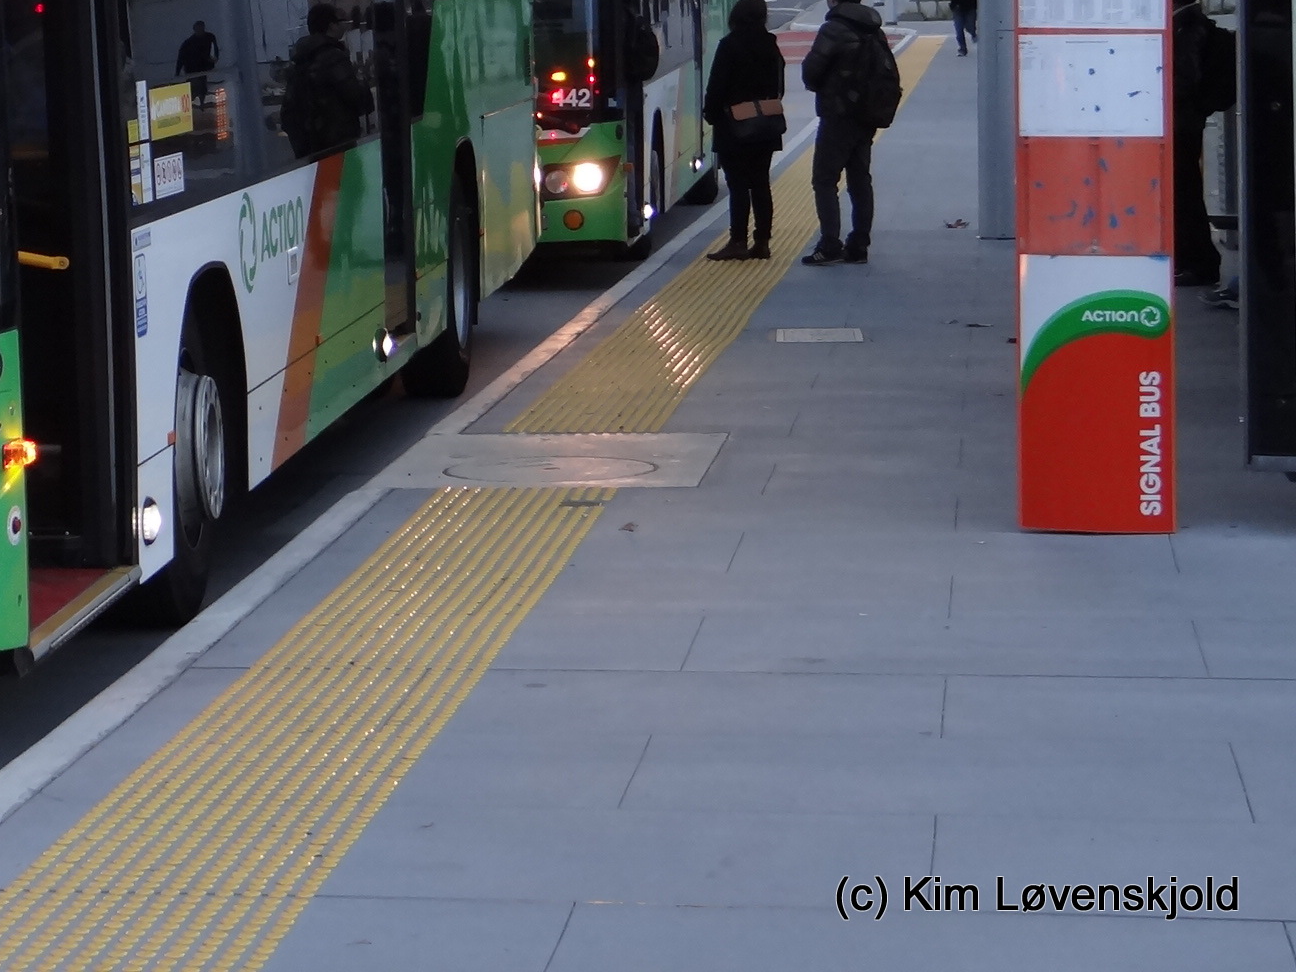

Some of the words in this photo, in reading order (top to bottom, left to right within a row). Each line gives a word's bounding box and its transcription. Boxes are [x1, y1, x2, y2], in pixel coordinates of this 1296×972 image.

[552, 88, 591, 107] 442
[261, 196, 304, 262] ACTION
[1081, 309, 1139, 323] ACTION
[1139, 370, 1162, 418] BUS
[1139, 424, 1162, 517] SIGNAL
